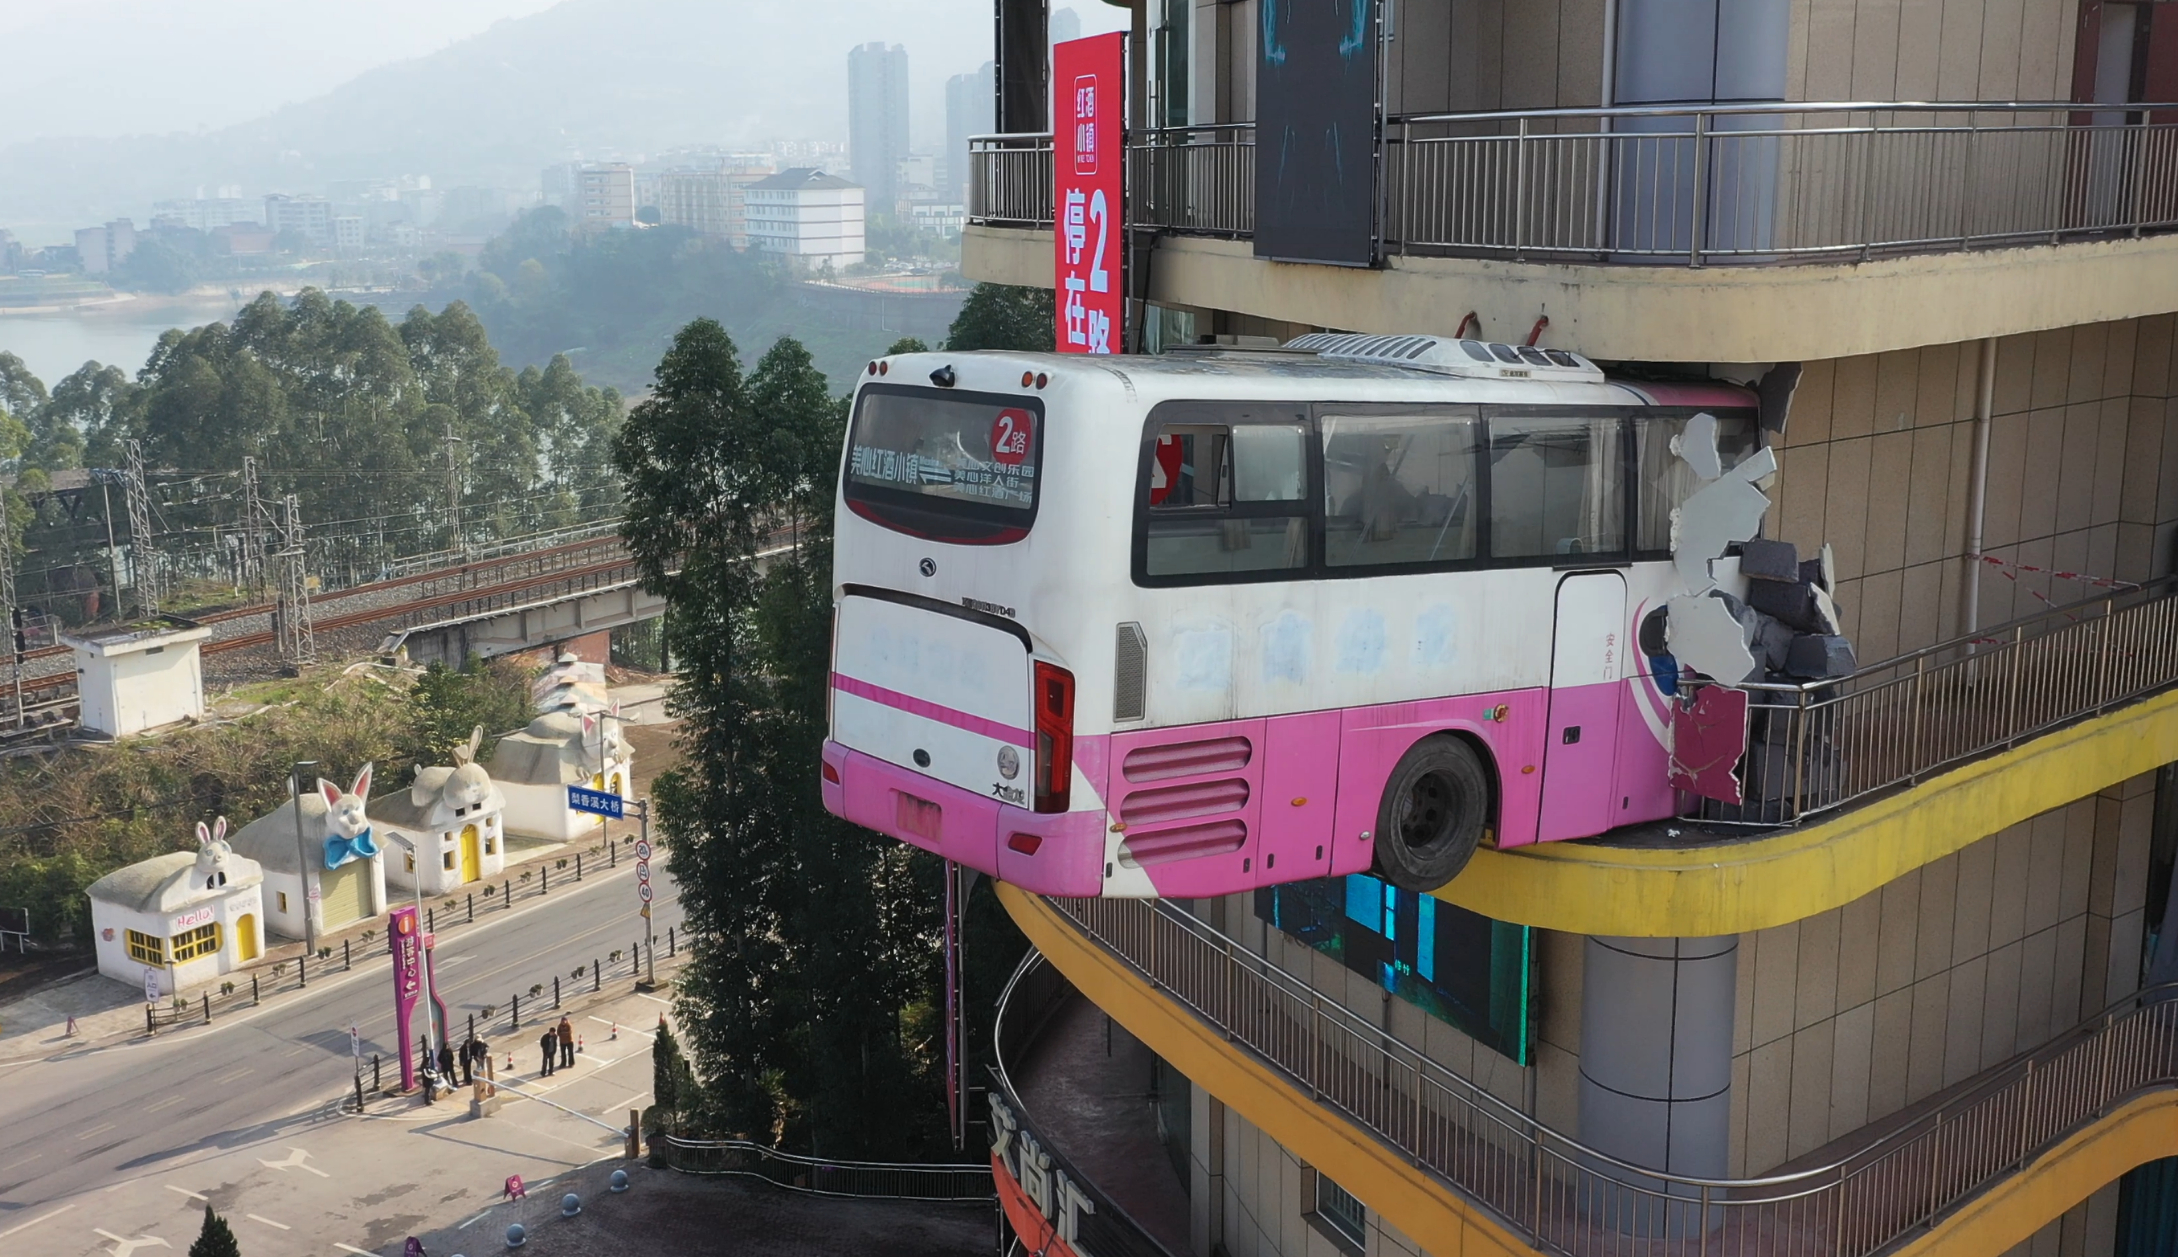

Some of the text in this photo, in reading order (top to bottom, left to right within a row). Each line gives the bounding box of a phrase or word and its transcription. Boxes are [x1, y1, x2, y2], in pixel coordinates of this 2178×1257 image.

[1077, 86, 1094, 118] 红酒
[1064, 187, 1086, 345] 停在
[996, 416, 1026, 455] 2路
[851, 444, 919, 485] 美心红酒小镇
[956, 457, 1034, 478] 美心文创乐园
[954, 469, 1019, 488] 美心洋人街
[953, 481, 1033, 504] 美心红酒广场
[1603, 632, 1616, 680] 安全门
[992, 782, 1025, 805] 大金龙
[641, 886, 650, 898] 40
[177, 905, 215, 928] Hello!
